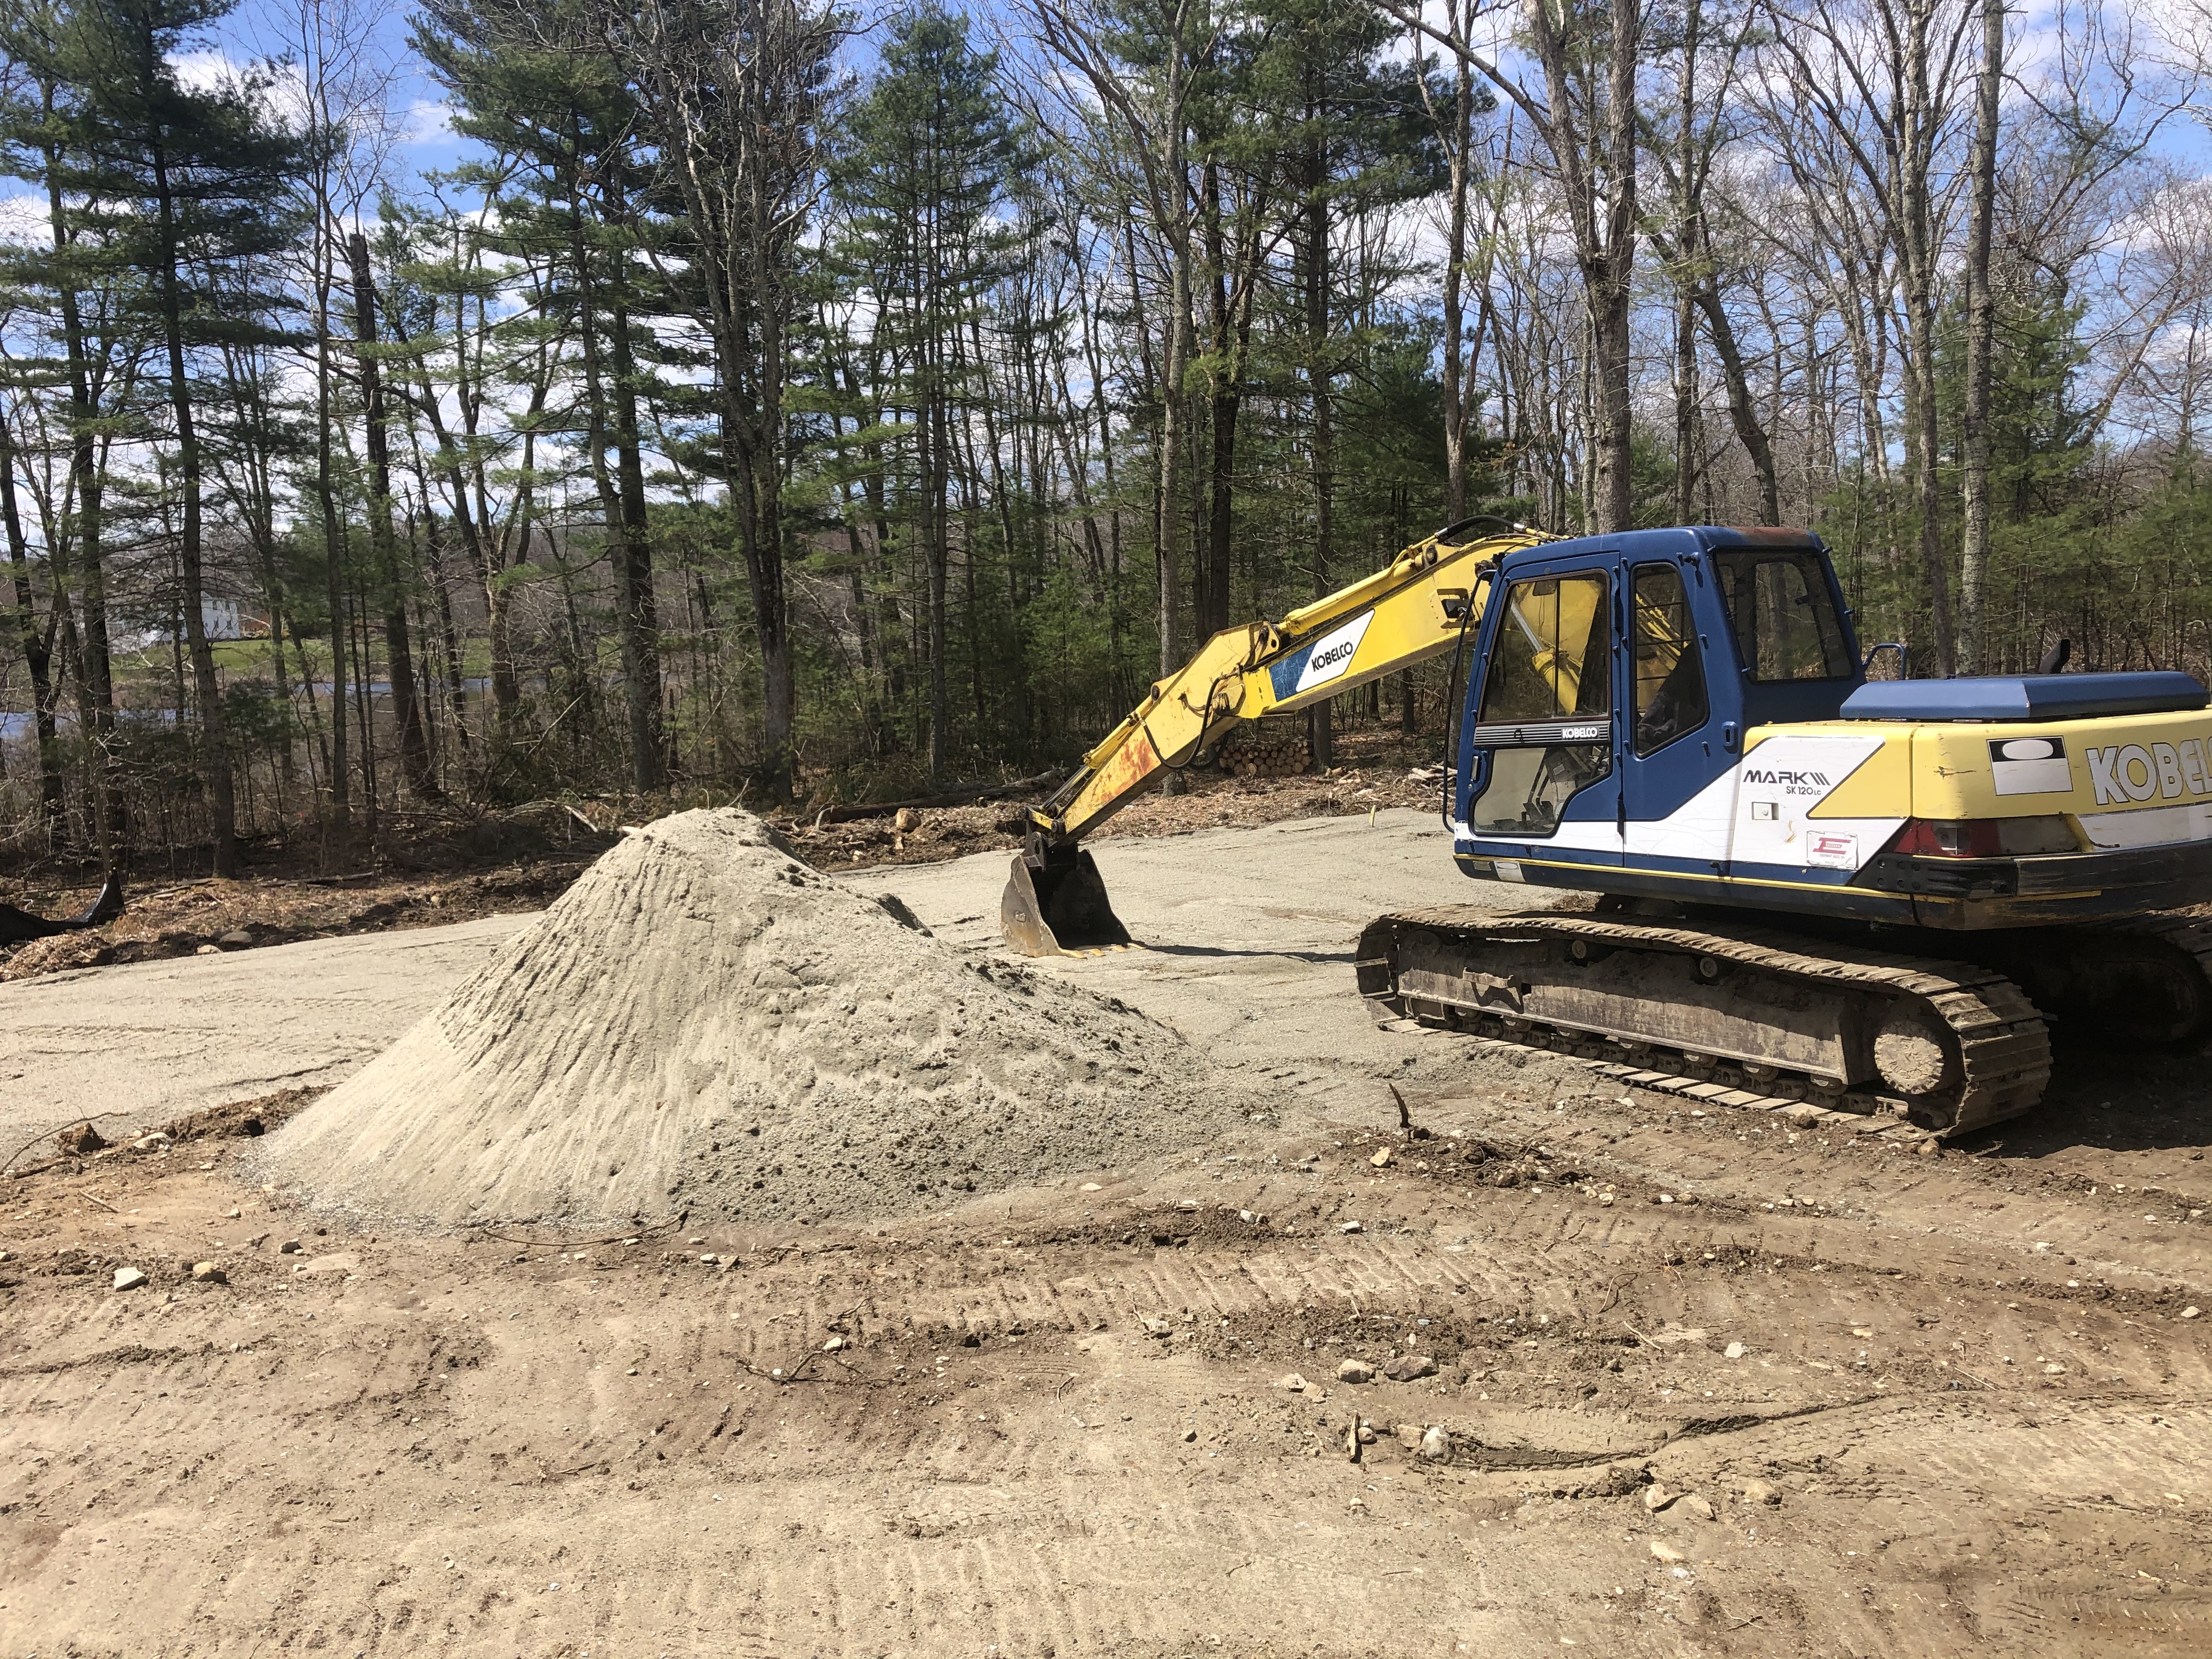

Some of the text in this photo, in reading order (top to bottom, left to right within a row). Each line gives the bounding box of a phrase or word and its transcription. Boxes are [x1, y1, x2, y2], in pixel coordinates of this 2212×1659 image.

[1311, 641, 1353, 673] KOBELCO
[1562, 727, 1598, 738] KOBELCO
[1743, 769, 1809, 785] MARK
[2085, 736, 2212, 806] KOBEL
[1786, 786, 1797, 794] SK
